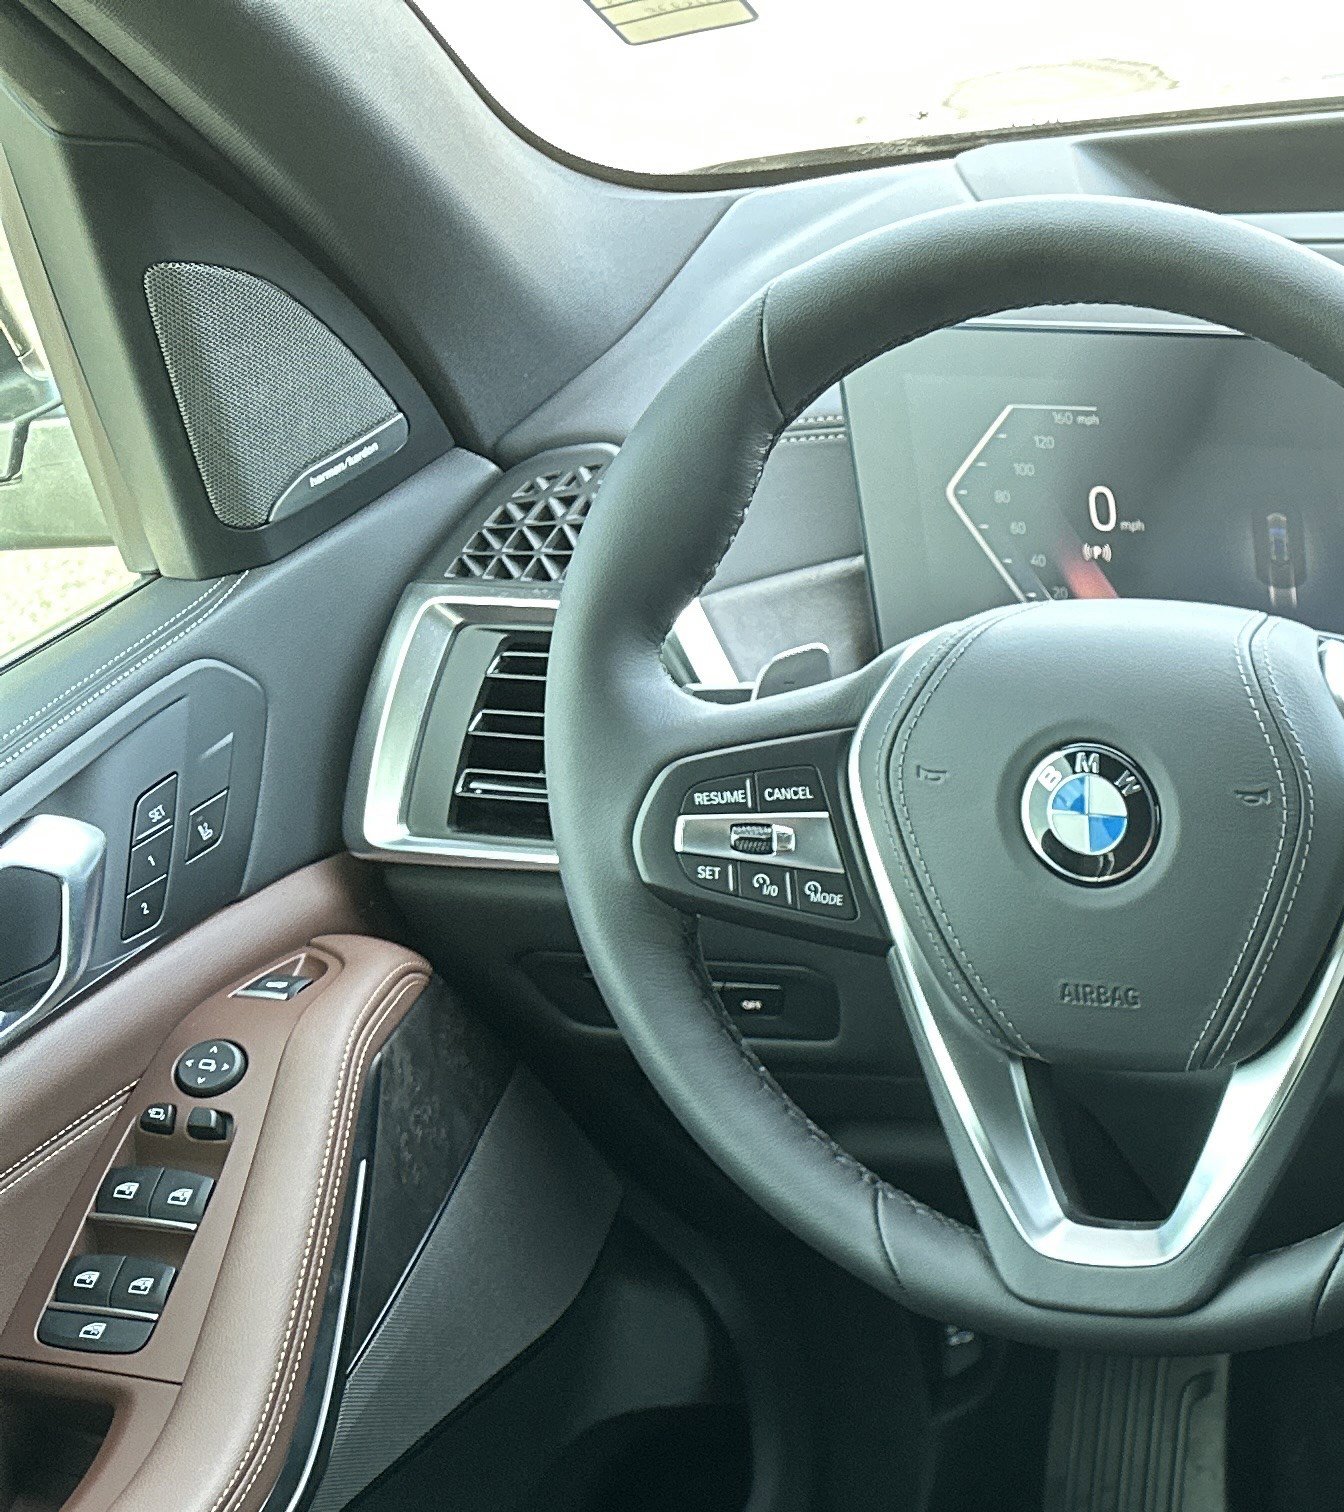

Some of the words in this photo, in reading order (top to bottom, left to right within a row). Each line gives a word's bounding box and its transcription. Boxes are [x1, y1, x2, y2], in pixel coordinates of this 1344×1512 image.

[1088, 485, 1117, 532] 0
[1030, 554, 1047, 568] 40
[1037, 751, 1142, 797] BMW
[694, 789, 747, 806] RESUME
[763, 786, 815, 802] CANCEL
[148, 804, 167, 823] SET
[147, 855, 156, 867] 1
[697, 865, 722, 880] SET
[809, 890, 844, 907] MODE
[140, 902, 150, 915] 2
[1059, 981, 1141, 1008] AIRBAG
